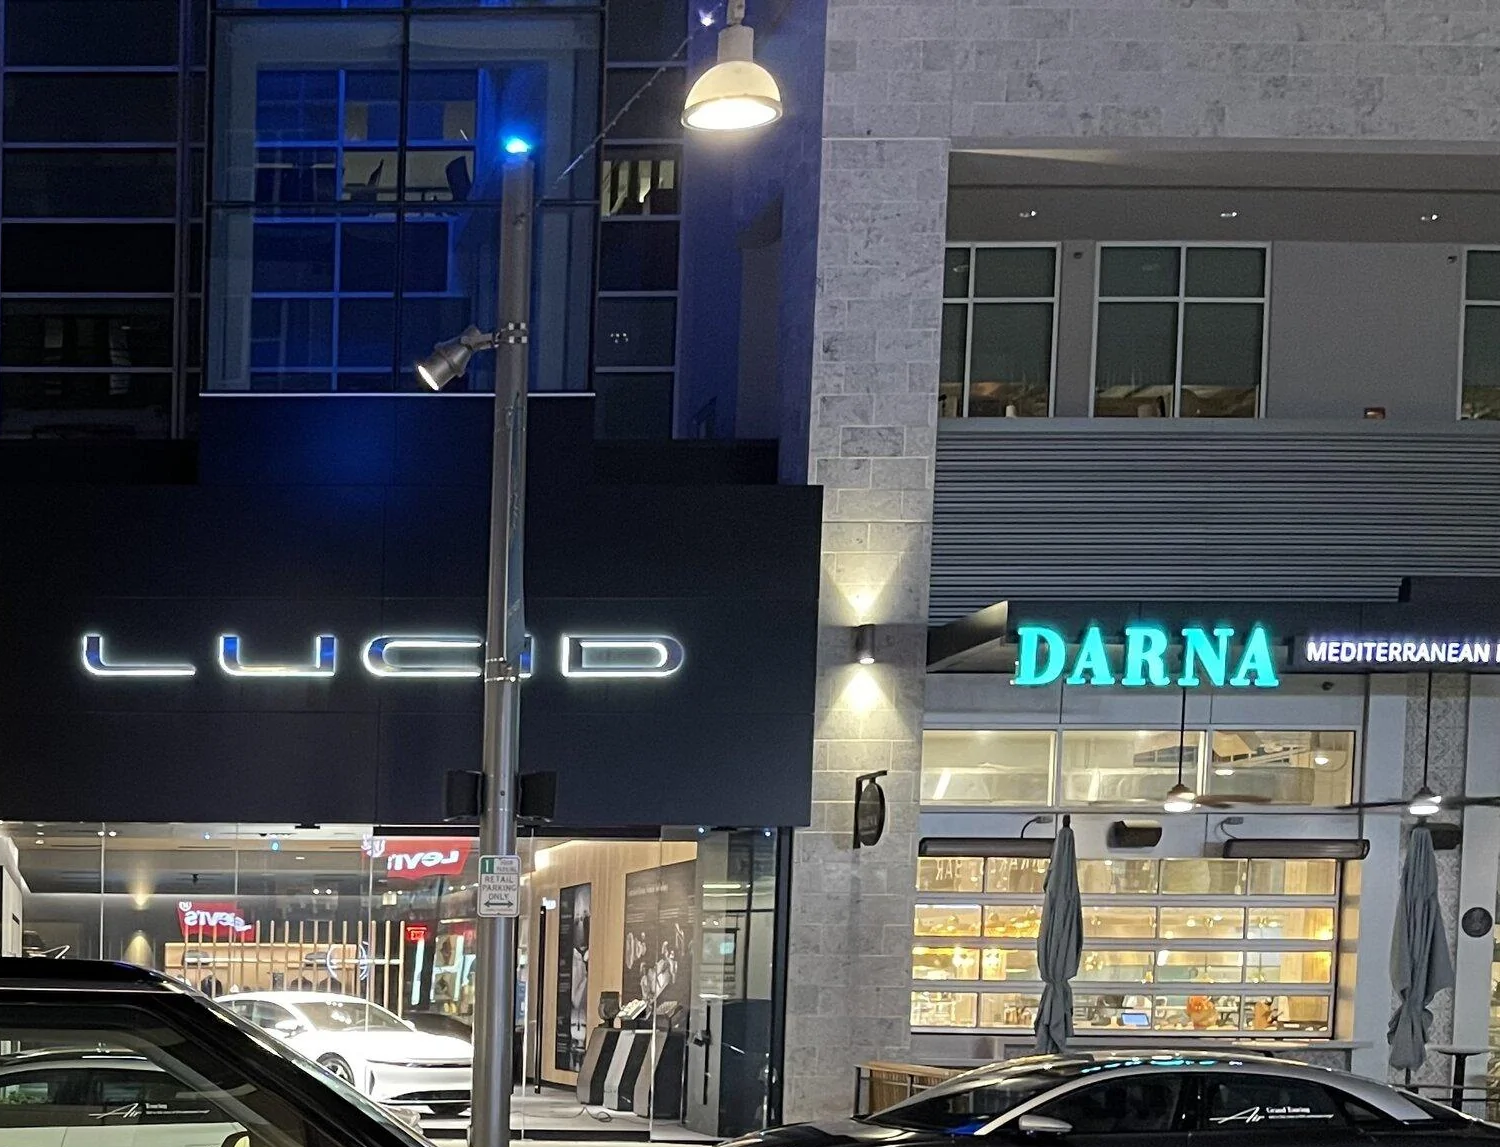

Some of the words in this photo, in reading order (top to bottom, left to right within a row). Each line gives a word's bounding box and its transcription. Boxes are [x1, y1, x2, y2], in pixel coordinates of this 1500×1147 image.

[83, 634, 684, 678] LUCID
[1014, 626, 1279, 686] DARNA
[1307, 641, 1490, 663] MEDITERRANEAN
[482, 884, 517, 892] PARKING
[485, 875, 514, 883] RETAIL
[1209, 1106, 1265, 1124] Air
